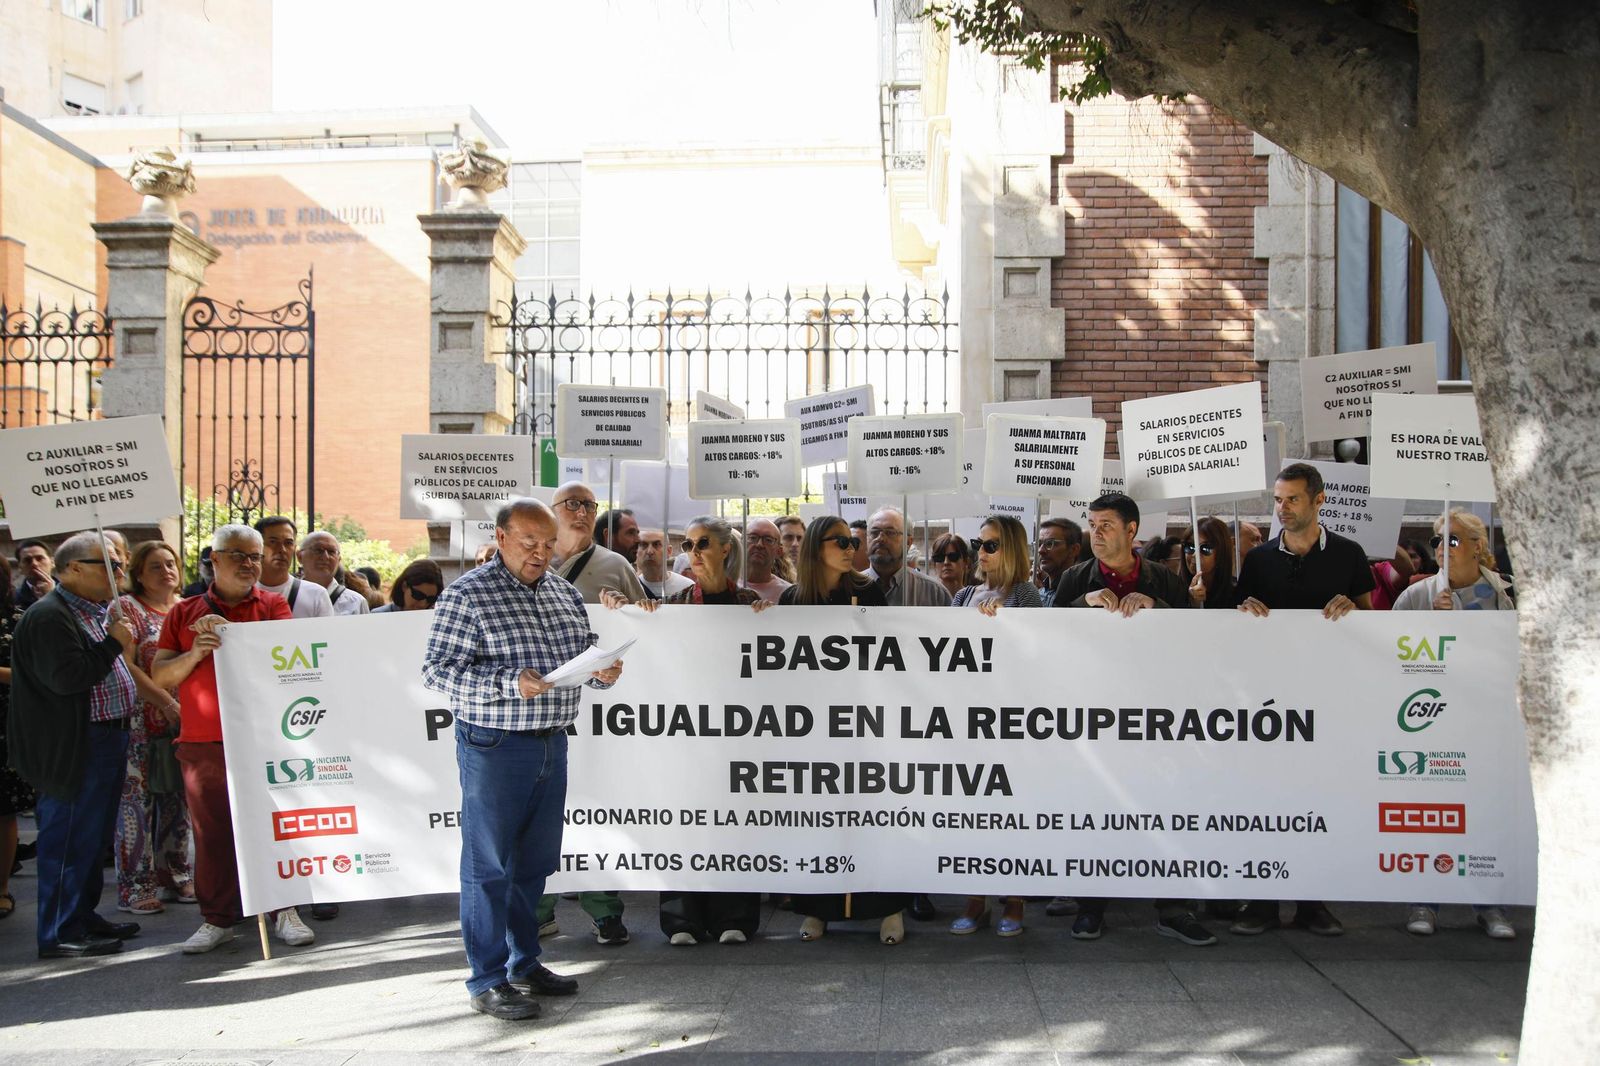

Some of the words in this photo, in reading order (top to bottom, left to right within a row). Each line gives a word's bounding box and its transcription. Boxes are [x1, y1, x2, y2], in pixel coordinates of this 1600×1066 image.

[208, 208, 256, 227] JUNTA
[267, 208, 287, 225] DE
[282, 231, 300, 245] del
[1325, 374, 1337, 383] C2
[1339, 369, 1383, 382] AUXILIAR
[1394, 365, 1411, 375] SMI
[1336, 382, 1389, 395] NOSOTROS
[1392, 380, 1401, 389] SI
[578, 395, 608, 403] SALARIOS
[641, 396, 649, 404] EN
[1324, 399, 1344, 410] QUE
[1346, 398, 1360, 406] NO
[581, 410, 614, 418] SERVICIOS
[616, 408, 646, 418] PÚBLICOS
[1339, 411, 1346, 420] A
[1348, 410, 1363, 419] FIN
[1366, 409, 1372, 417] D
[801, 418, 837, 431] OSOTROS/AS
[1140, 416, 1187, 431] SALARIOS
[1189, 408, 1242, 424] DECENTES
[596, 424, 604, 432] DE
[606, 424, 631, 432] CALIDAD
[863, 430, 891, 440] JUANMA
[893, 430, 925, 439] MORENO
[926, 429, 932, 438] Y
[934, 428, 949, 438] SUS
[702, 435, 731, 444] JUANMA
[732, 434, 763, 443] MORENO
[764, 434, 770, 442] Y
[770, 434, 785, 442] SUS
[801, 434, 829, 445] LEGAMOS
[1010, 428, 1041, 439] JUANMA
[1043, 429, 1086, 441] MALTRATA
[1157, 434, 1170, 444] EN
[1172, 426, 1225, 442] SERVICIOS
[1391, 434, 1405, 443] ES
[1408, 434, 1440, 444] HORA
[1444, 436, 1458, 445] DE
[584, 438, 609, 447] ¡SUBIDA
[611, 439, 642, 447] SALARIAL!
[1014, 442, 1079, 455] SALARIALMENTE
[27, 451, 43, 462] C2
[46, 444, 103, 460] AUXILIAR
[116, 441, 137, 452] SMI
[418, 452, 464, 462] SALARIOS
[466, 453, 514, 462] DECENTES
[704, 452, 728, 461] ALTOS
[729, 452, 761, 460] CARGOS:
[762, 451, 782, 460] +18%
[866, 448, 887, 457] ALTOS
[889, 447, 923, 456] CARGOS:
[924, 446, 945, 455] +18%
[1138, 446, 1187, 462] PÚBLICOS
[1188, 444, 1202, 455] DE
[1204, 440, 1248, 454] CALIDAD
[1397, 450, 1451, 461] NUESTRO
[1454, 452, 1489, 462] TRABA
[45, 461, 114, 477] NOSOTROS
[117, 458, 129, 468] SI
[434, 466, 446, 474] EN
[449, 466, 498, 475] SERVICIOS
[889, 466, 901, 475] TÚ:
[902, 466, 920, 475] -16%
[1015, 459, 1020, 467] A
[1022, 460, 1033, 469] SU
[1034, 460, 1075, 471] PERSONAL
[1146, 463, 1186, 478] ¡SUBIDA
[1188, 458, 1240, 472] SALARIAL!
[728, 469, 740, 479] TÚ:
[742, 470, 759, 479] -16%
[32, 483, 59, 496] QUE
[63, 480, 80, 491] NO
[84, 471, 148, 489] LLEGAMOS
[414, 476, 462, 487] PÚBLICOS
[464, 479, 475, 487] DE
[478, 479, 517, 488] CALIDAD
[1016, 475, 1071, 487] FUNCIONARIO
[1341, 484, 1370, 494] MORE
[56, 499, 64, 508] A
[67, 496, 87, 506] FIN
[91, 493, 106, 503] DE
[109, 489, 134, 500] MES
[422, 491, 460, 501] ¡SUBIDA
[462, 492, 509, 500] SALARIAL!
[1325, 496, 1336, 504] US
[1338, 498, 1367, 507] ALTOS
[997, 504, 1024, 512] VALORAR
[1319, 509, 1341, 518] GOS:
[1350, 512, 1361, 520] 18
[1364, 514, 1373, 522] %
[1334, 524, 1345, 532] 16
[740, 636, 906, 678] ¡BASTA
[919, 637, 993, 673] YA!
[1407, 702, 1447, 718] CSIF
[290, 710, 326, 726] CSIF
[592, 703, 814, 738] IGUALDAD
[828, 706, 884, 738] EN
[901, 706, 954, 740] LA
[968, 698, 1315, 742] RECUPERACIÓN
[316, 756, 351, 764] INICIATIVA
[1430, 760, 1461, 768] SINDICAL
[318, 764, 348, 772] SINDICAL
[319, 773, 353, 781] ANDALUZA
[730, 761, 1014, 797] RETRIBUTIVA
[279, 813, 352, 834] CCOO
[563, 808, 673, 827] NCIONARIO
[680, 810, 707, 826] DE
[714, 810, 739, 826] LA
[745, 806, 925, 828] ADMINISTRACIÓN
[932, 812, 1030, 830] GENERAL
[1036, 814, 1063, 830] DE
[1070, 814, 1095, 831] LA
[1101, 814, 1165, 832] JUNTA
[1172, 815, 1199, 831] DE
[1206, 811, 1328, 833] ANDALUCÍA
[1385, 810, 1459, 827] CCOO
[277, 856, 327, 879] UGT
[596, 854, 608, 871] Y
[615, 853, 683, 872] ALTOS
[690, 854, 789, 874] CARGOS:
[795, 856, 856, 874] +18%
[938, 856, 1058, 877] PERSONAL
[1065, 860, 1229, 879] FUNCIONARIO:
[1235, 860, 1289, 880] -16%
[1379, 854, 1429, 873] UGT
